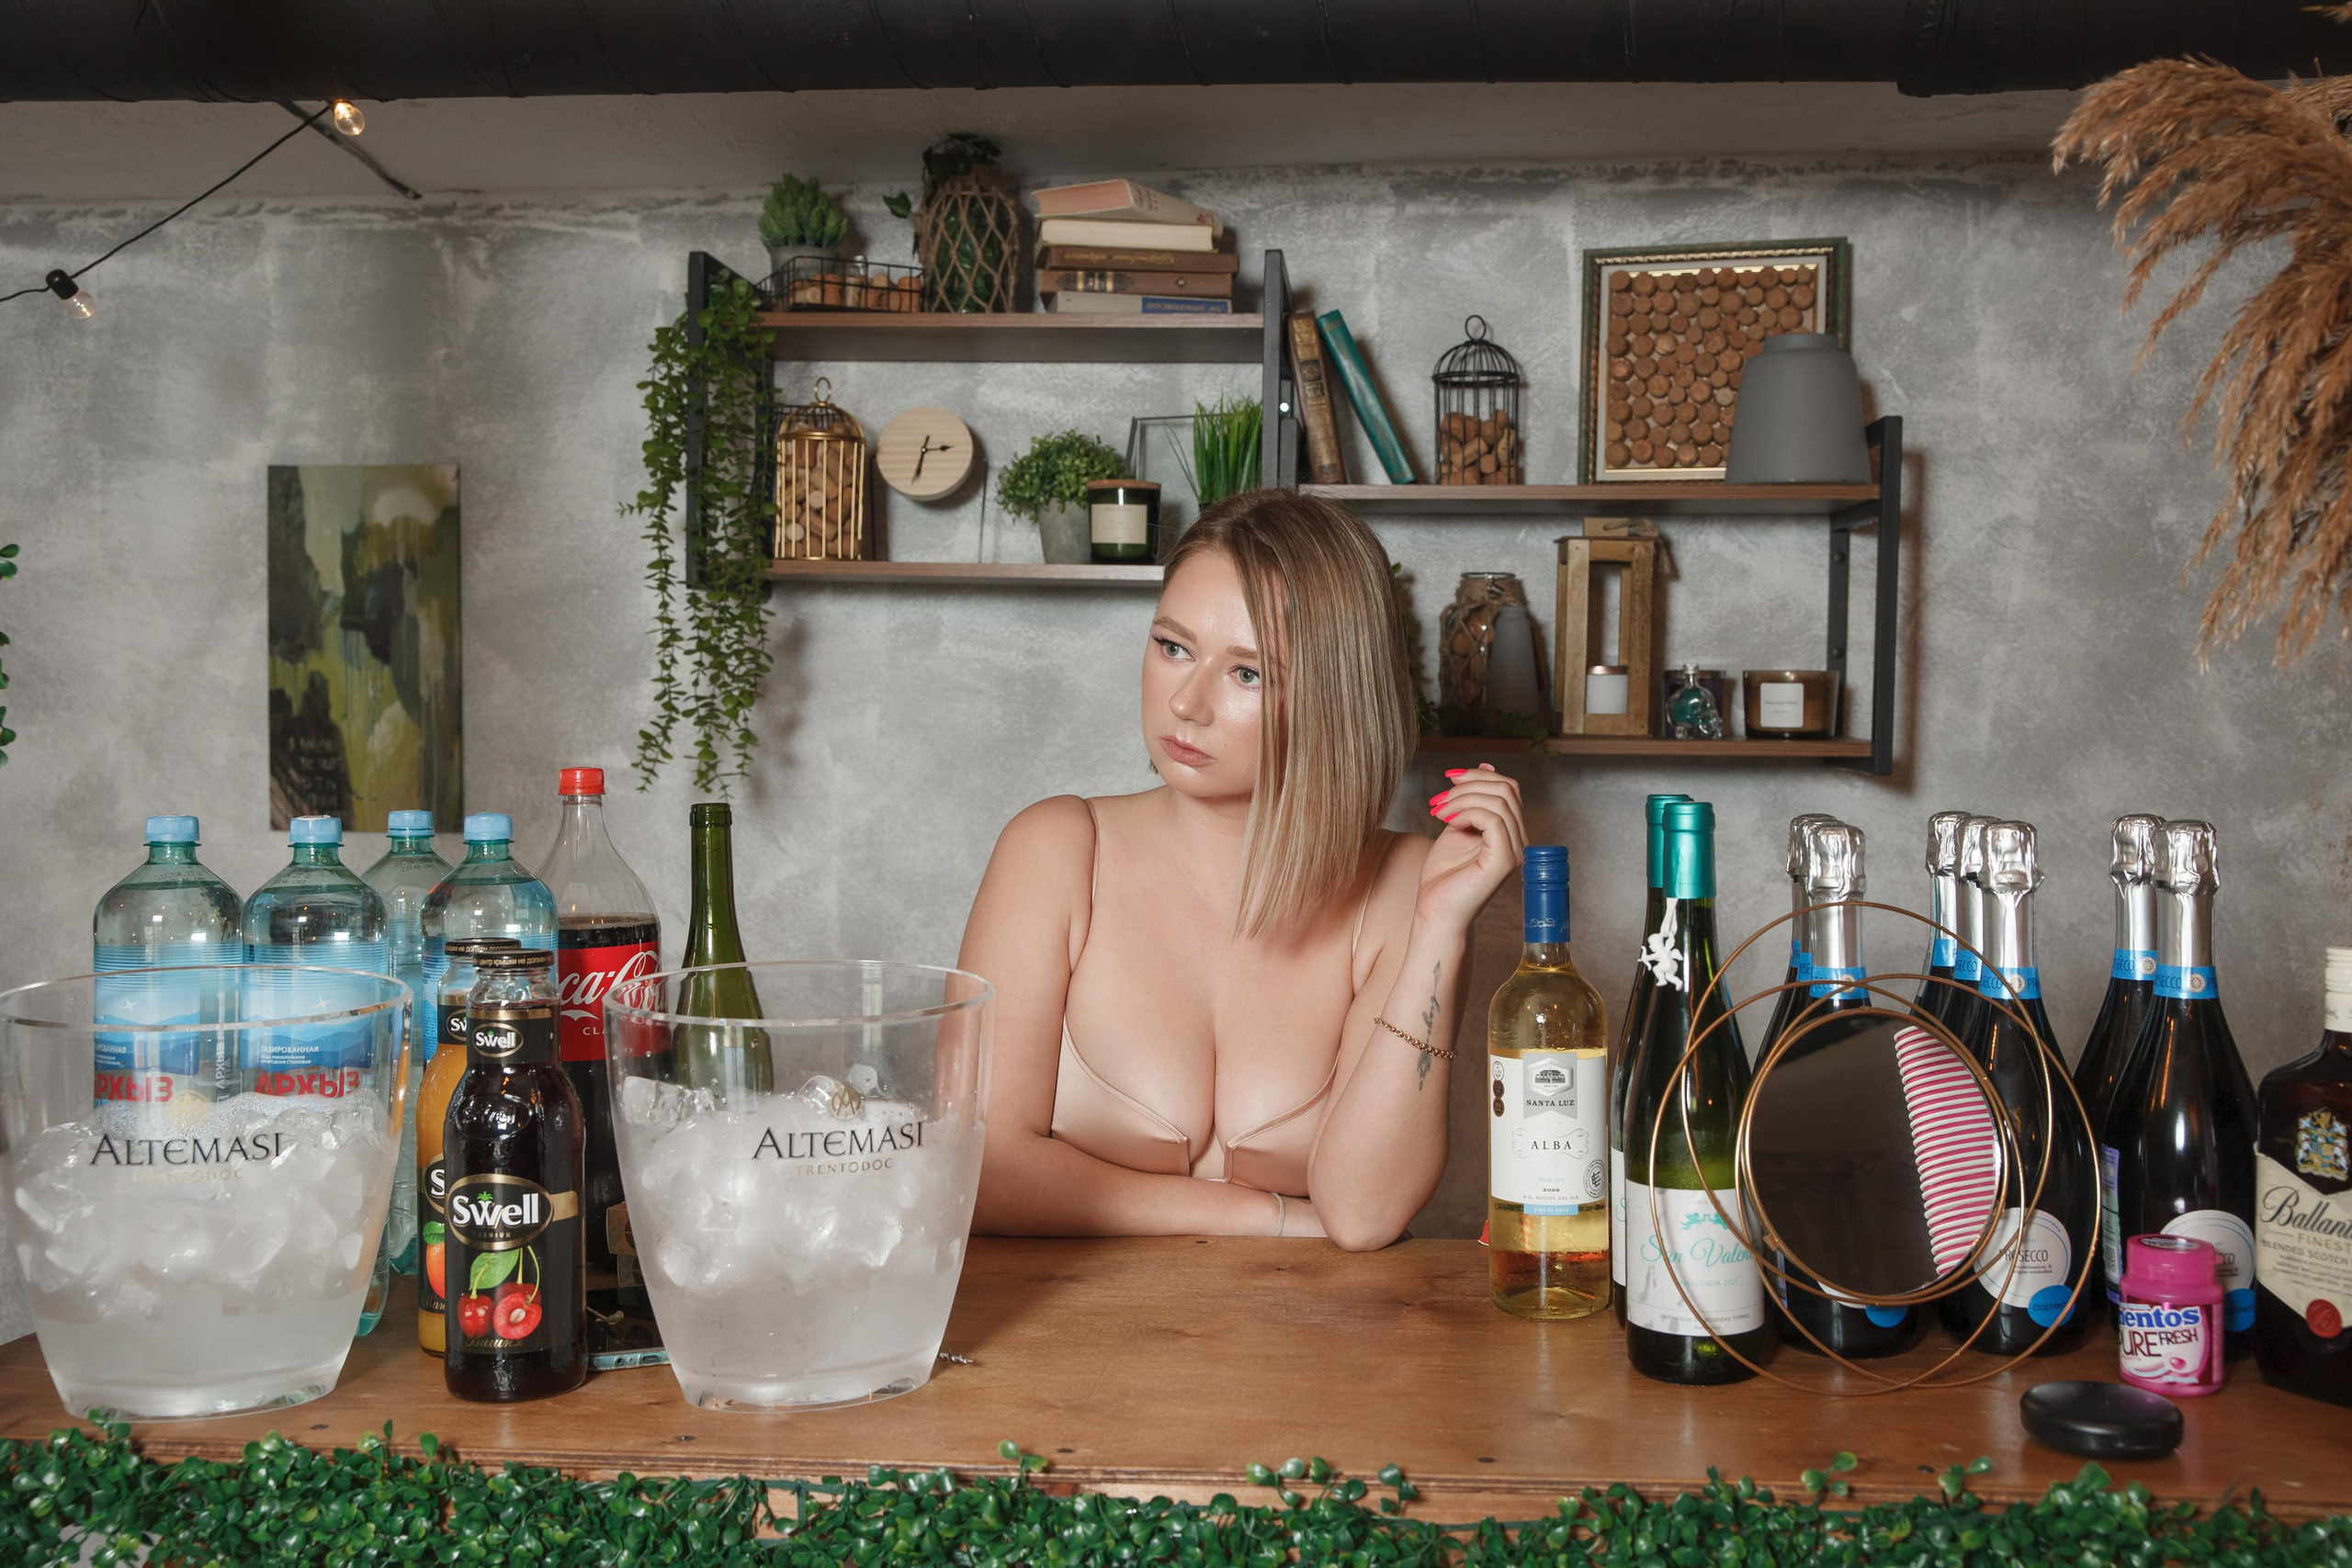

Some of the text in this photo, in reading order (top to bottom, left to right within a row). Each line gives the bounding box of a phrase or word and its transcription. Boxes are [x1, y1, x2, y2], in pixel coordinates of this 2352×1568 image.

[261, 1045, 320, 1054] ГАЗИРОВАННАЯ
[475, 1031, 516, 1049] Swell
[94, 1073, 174, 1102] РХЫЗ
[254, 1071, 359, 1099] АРХЫЗ
[1526, 1099, 1575, 1107] SANTA LUZ
[89, 1133, 284, 1167] ALTEMASI
[751, 1122, 925, 1160] ALTEMASI
[1531, 1140, 1572, 1150] ALBA
[796, 1157, 894, 1176] TRENTODOC
[452, 1192, 540, 1228] Swell
[1690, 1236, 1752, 1269] Valen
[2298, 1233, 2352, 1254] FINEST
[2307, 1249, 2349, 1266] SCOTCH
[2119, 1328, 2199, 1358] URE FRESH
